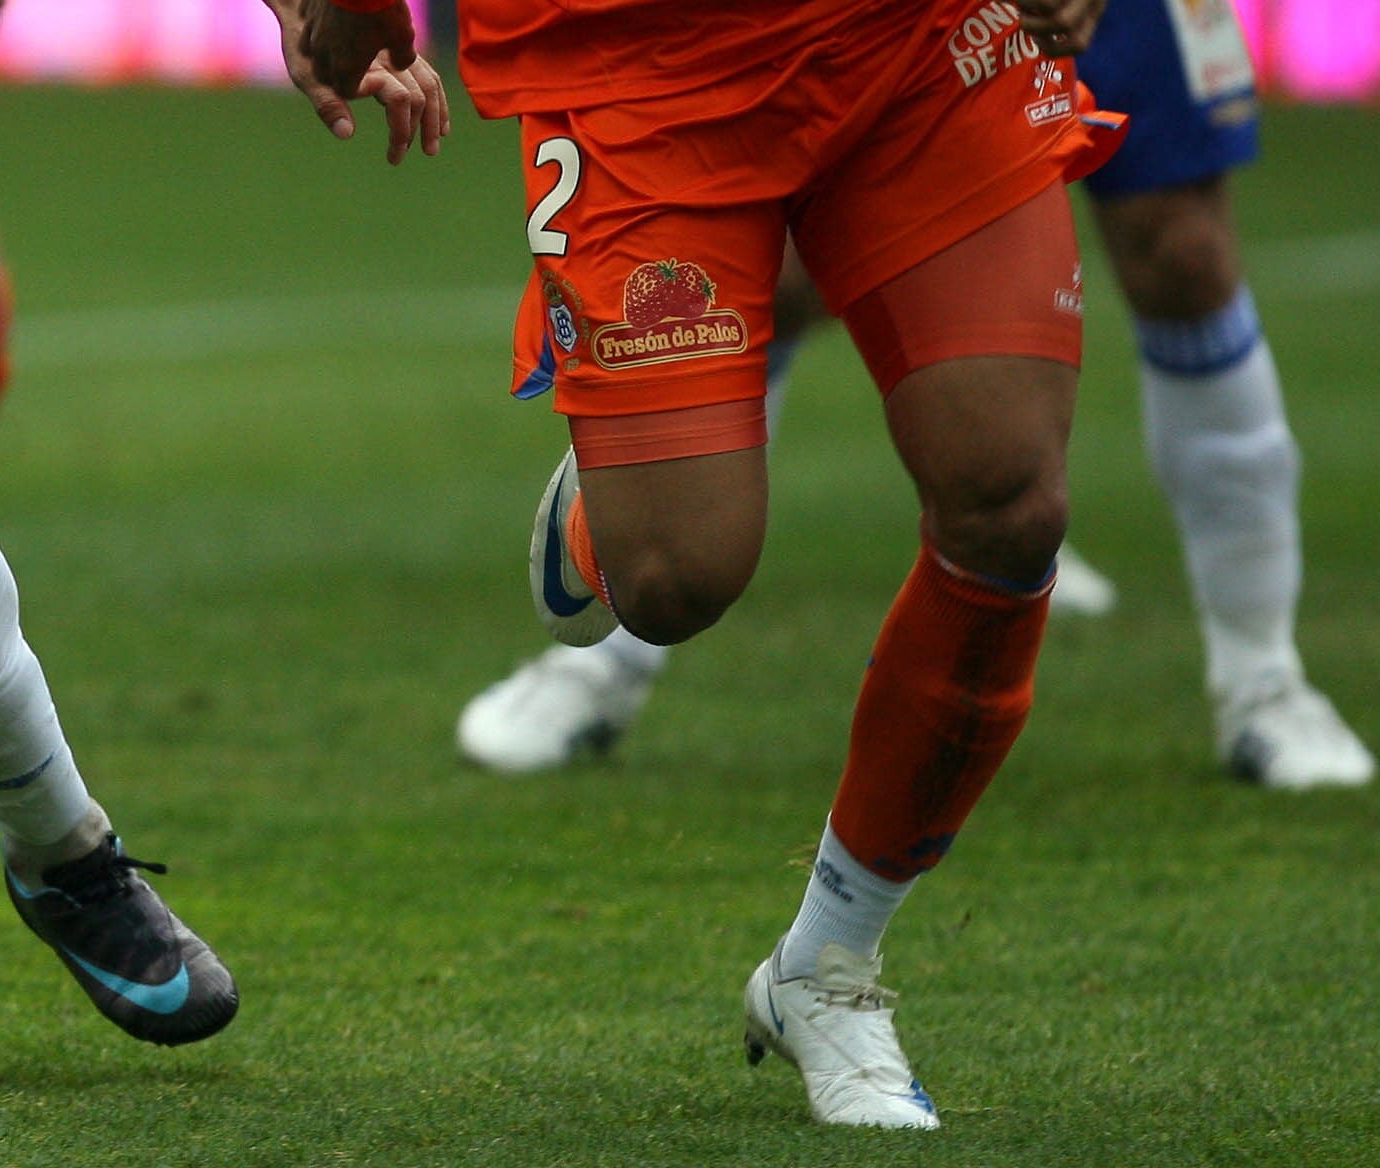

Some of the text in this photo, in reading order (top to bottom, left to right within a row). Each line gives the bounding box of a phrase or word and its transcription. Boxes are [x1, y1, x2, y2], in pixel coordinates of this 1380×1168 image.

[954, 30, 1040, 88] DE HU
[526, 136, 581, 257] 2
[600, 320, 740, 360] Fresón de Palos
